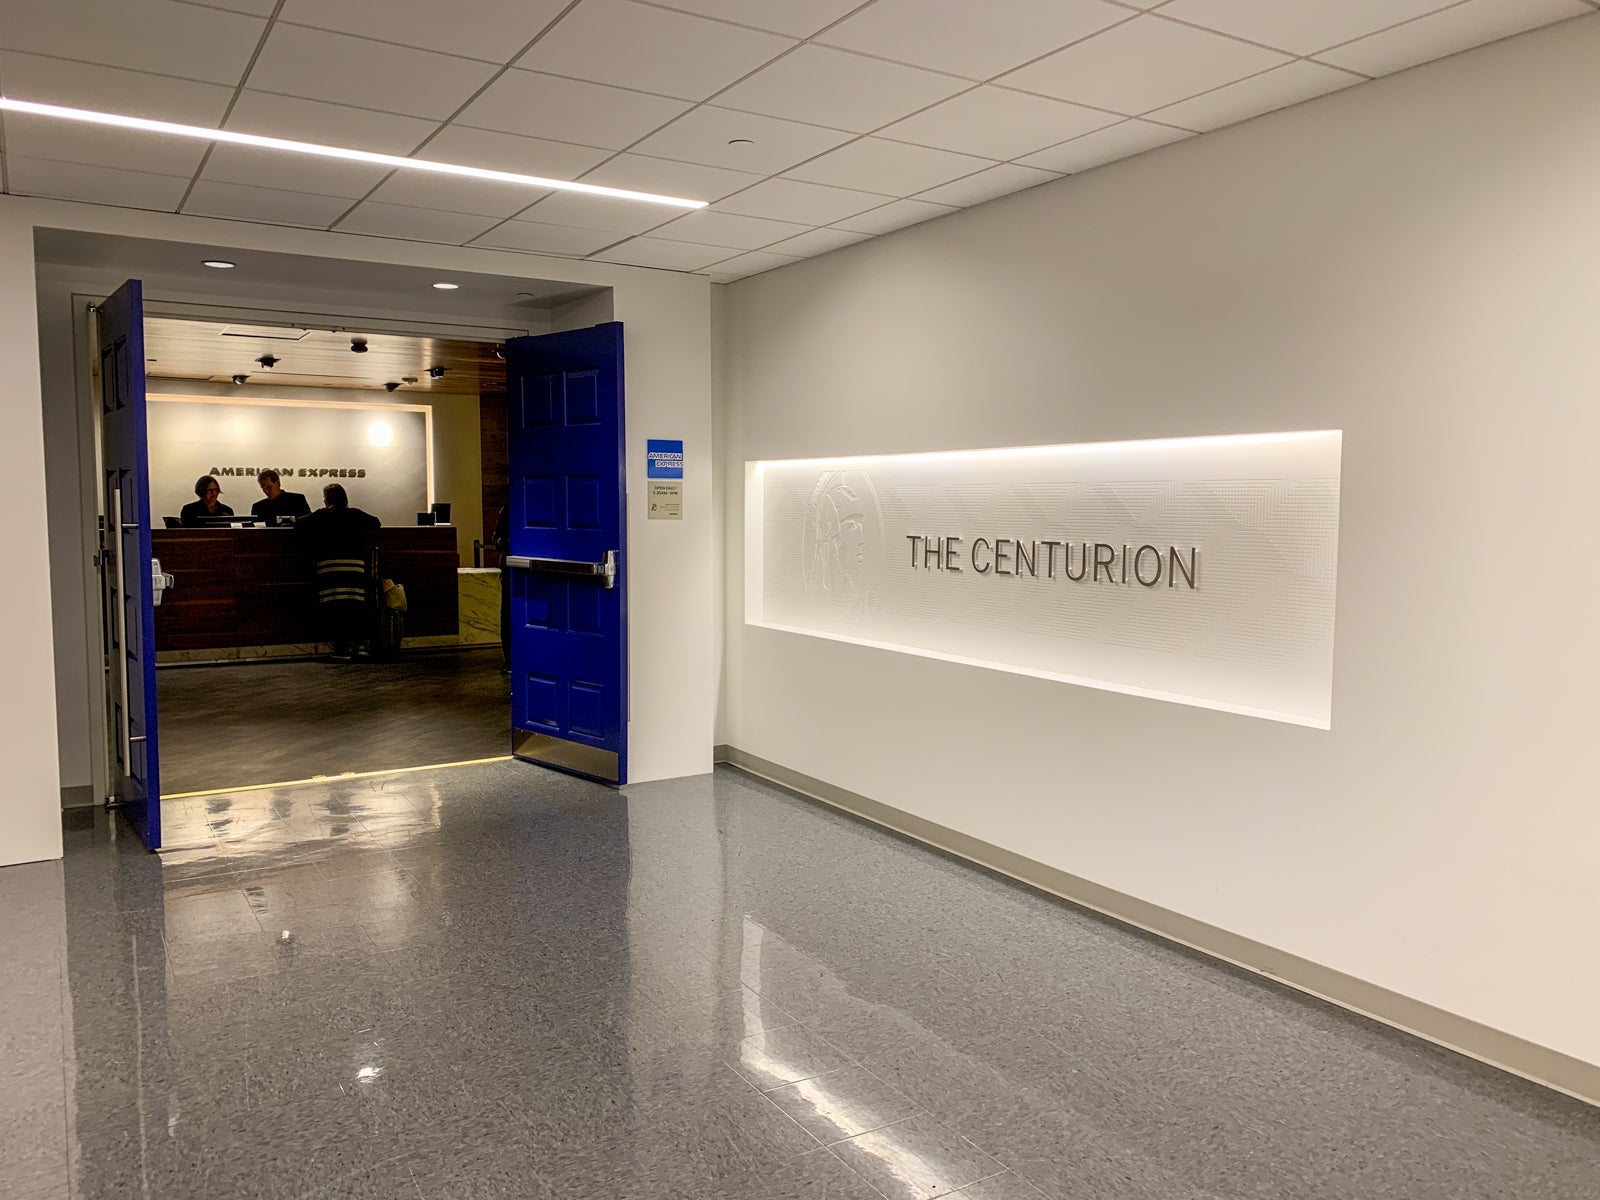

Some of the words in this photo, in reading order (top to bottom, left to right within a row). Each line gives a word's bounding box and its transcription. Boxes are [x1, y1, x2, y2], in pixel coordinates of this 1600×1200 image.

[209, 467, 293, 477] AMERIAN
[298, 468, 366, 478] EXPRESS
[906, 535, 960, 571] THE
[971, 537, 1196, 590] CENTURION
